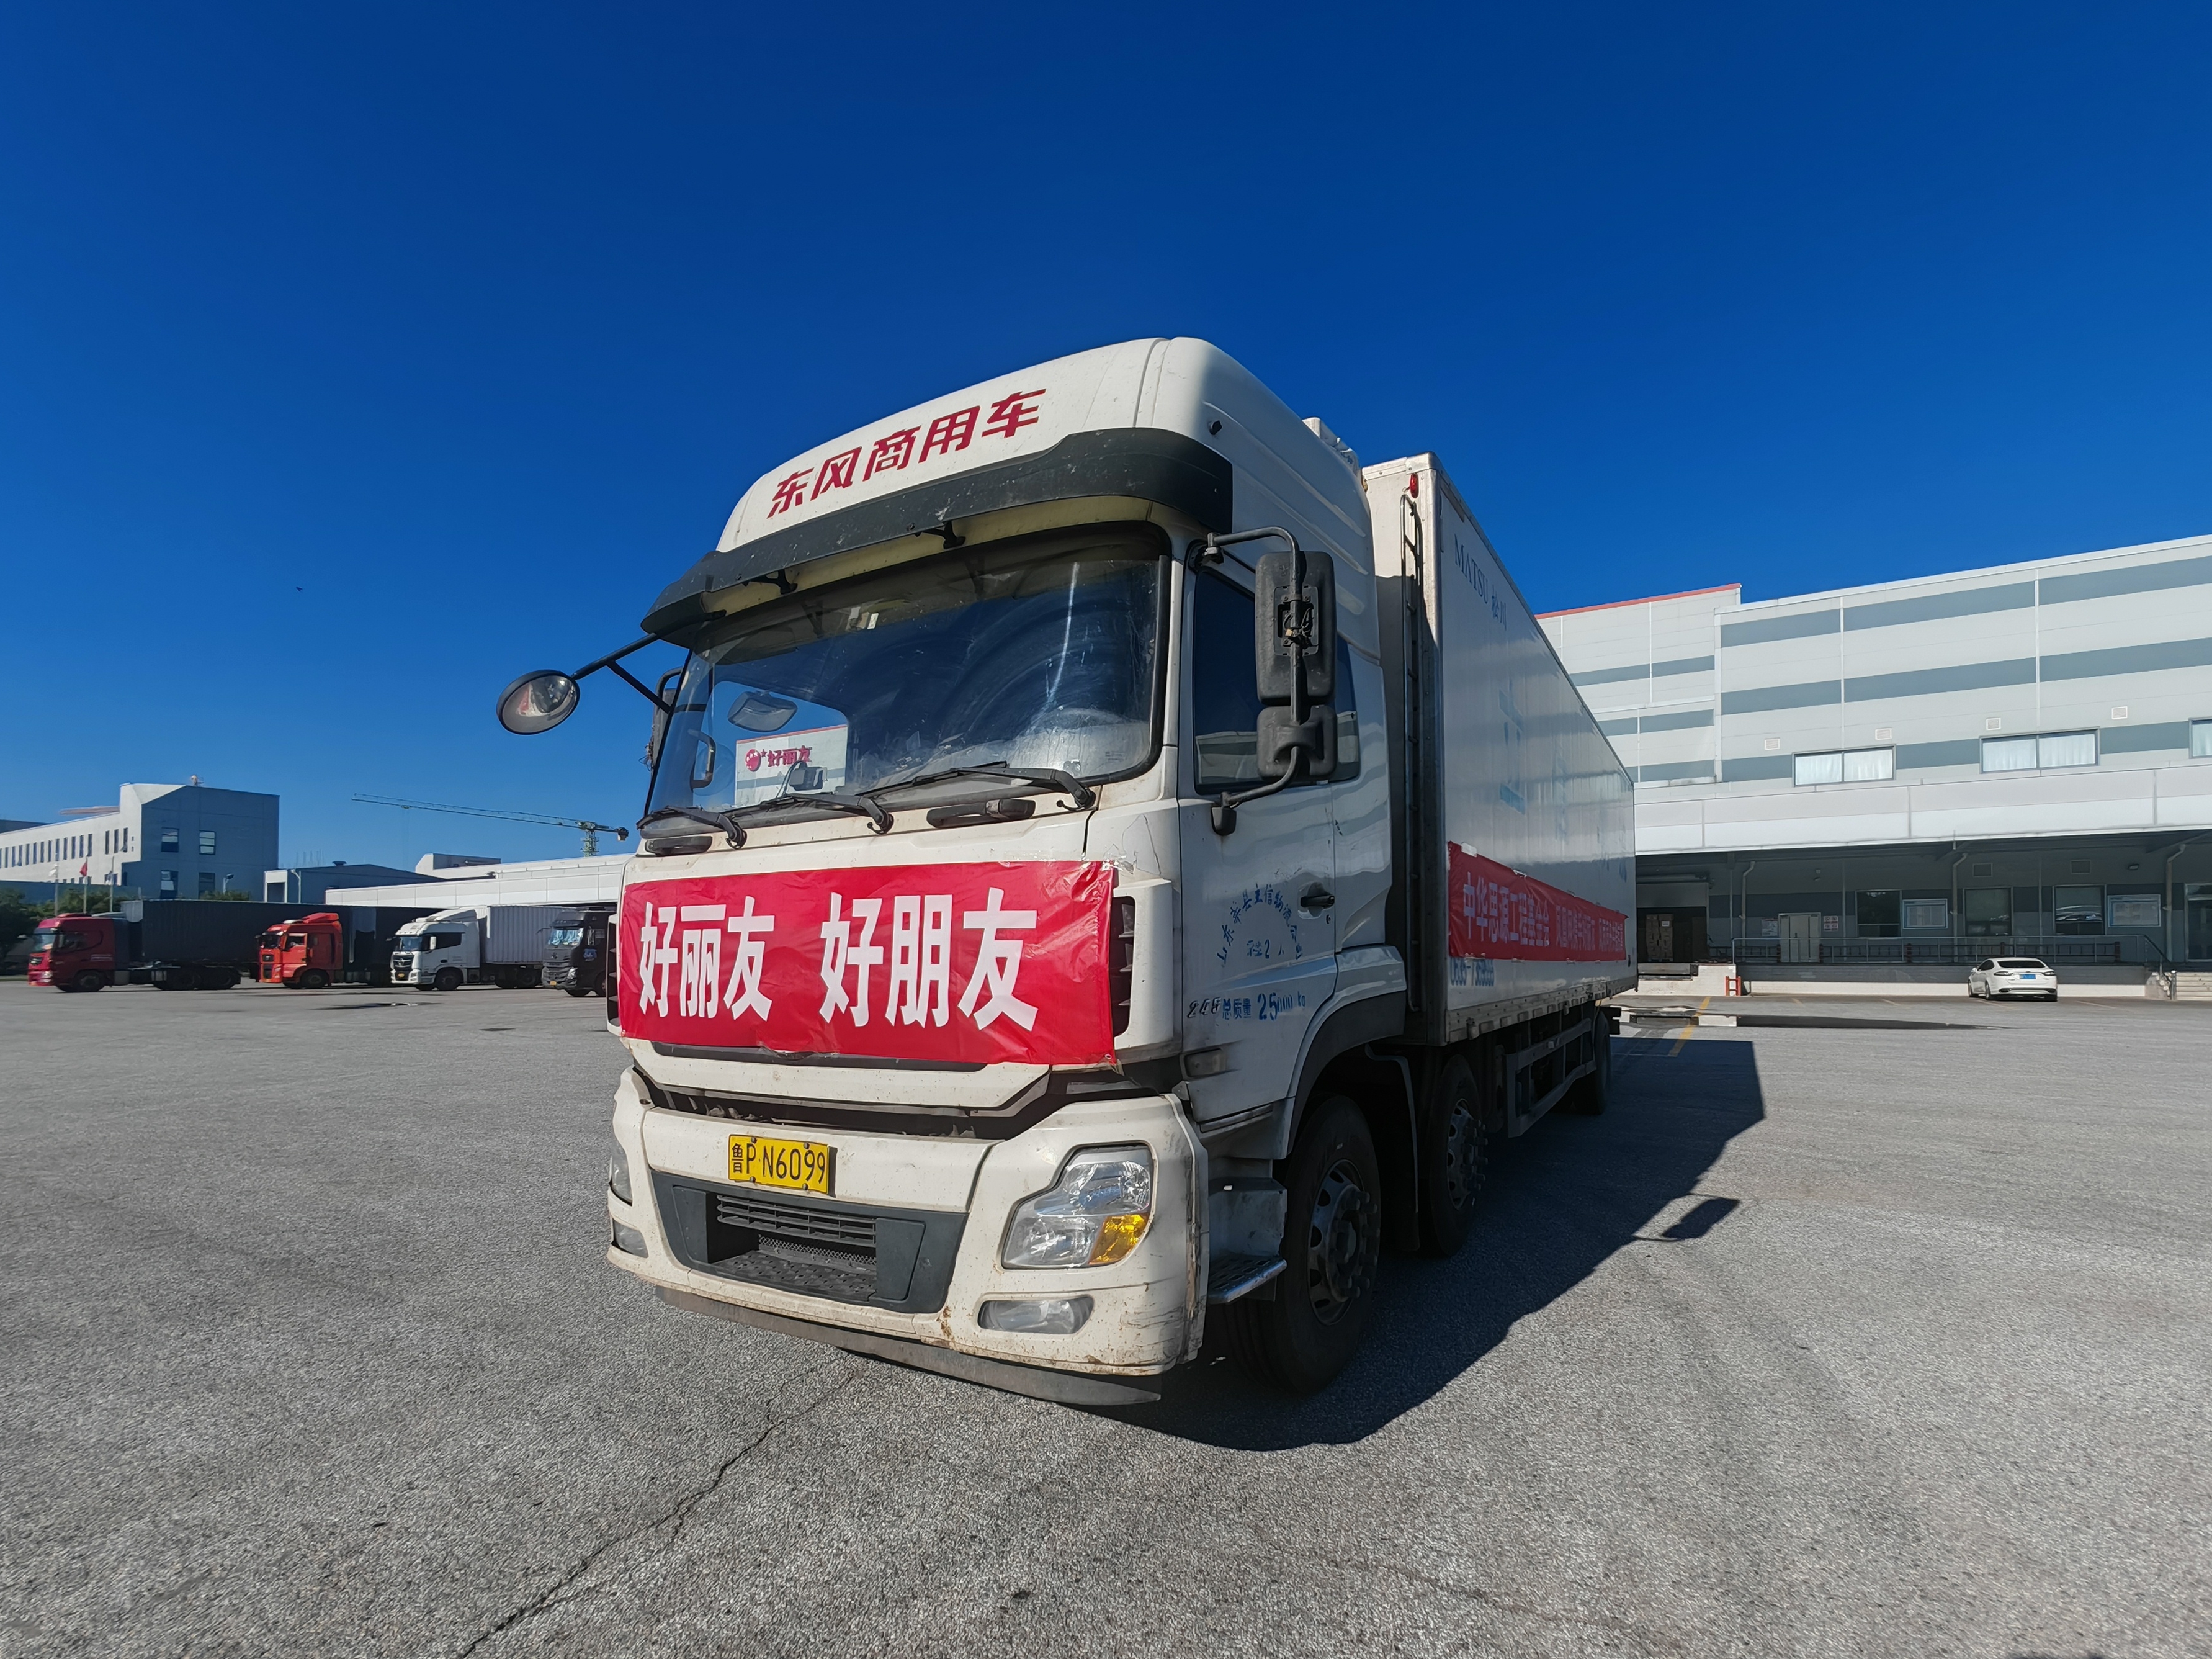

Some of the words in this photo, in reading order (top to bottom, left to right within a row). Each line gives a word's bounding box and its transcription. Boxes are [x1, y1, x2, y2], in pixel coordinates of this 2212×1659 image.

[766, 388, 1047, 519] 东风商用车
[1454, 533, 1488, 605] MATSU
[767, 745, 813, 767] 好丽友
[639, 896, 775, 1022] 好丽友
[819, 886, 1039, 1032] 好朋友
[1222, 998, 1252, 1020] 总质量
